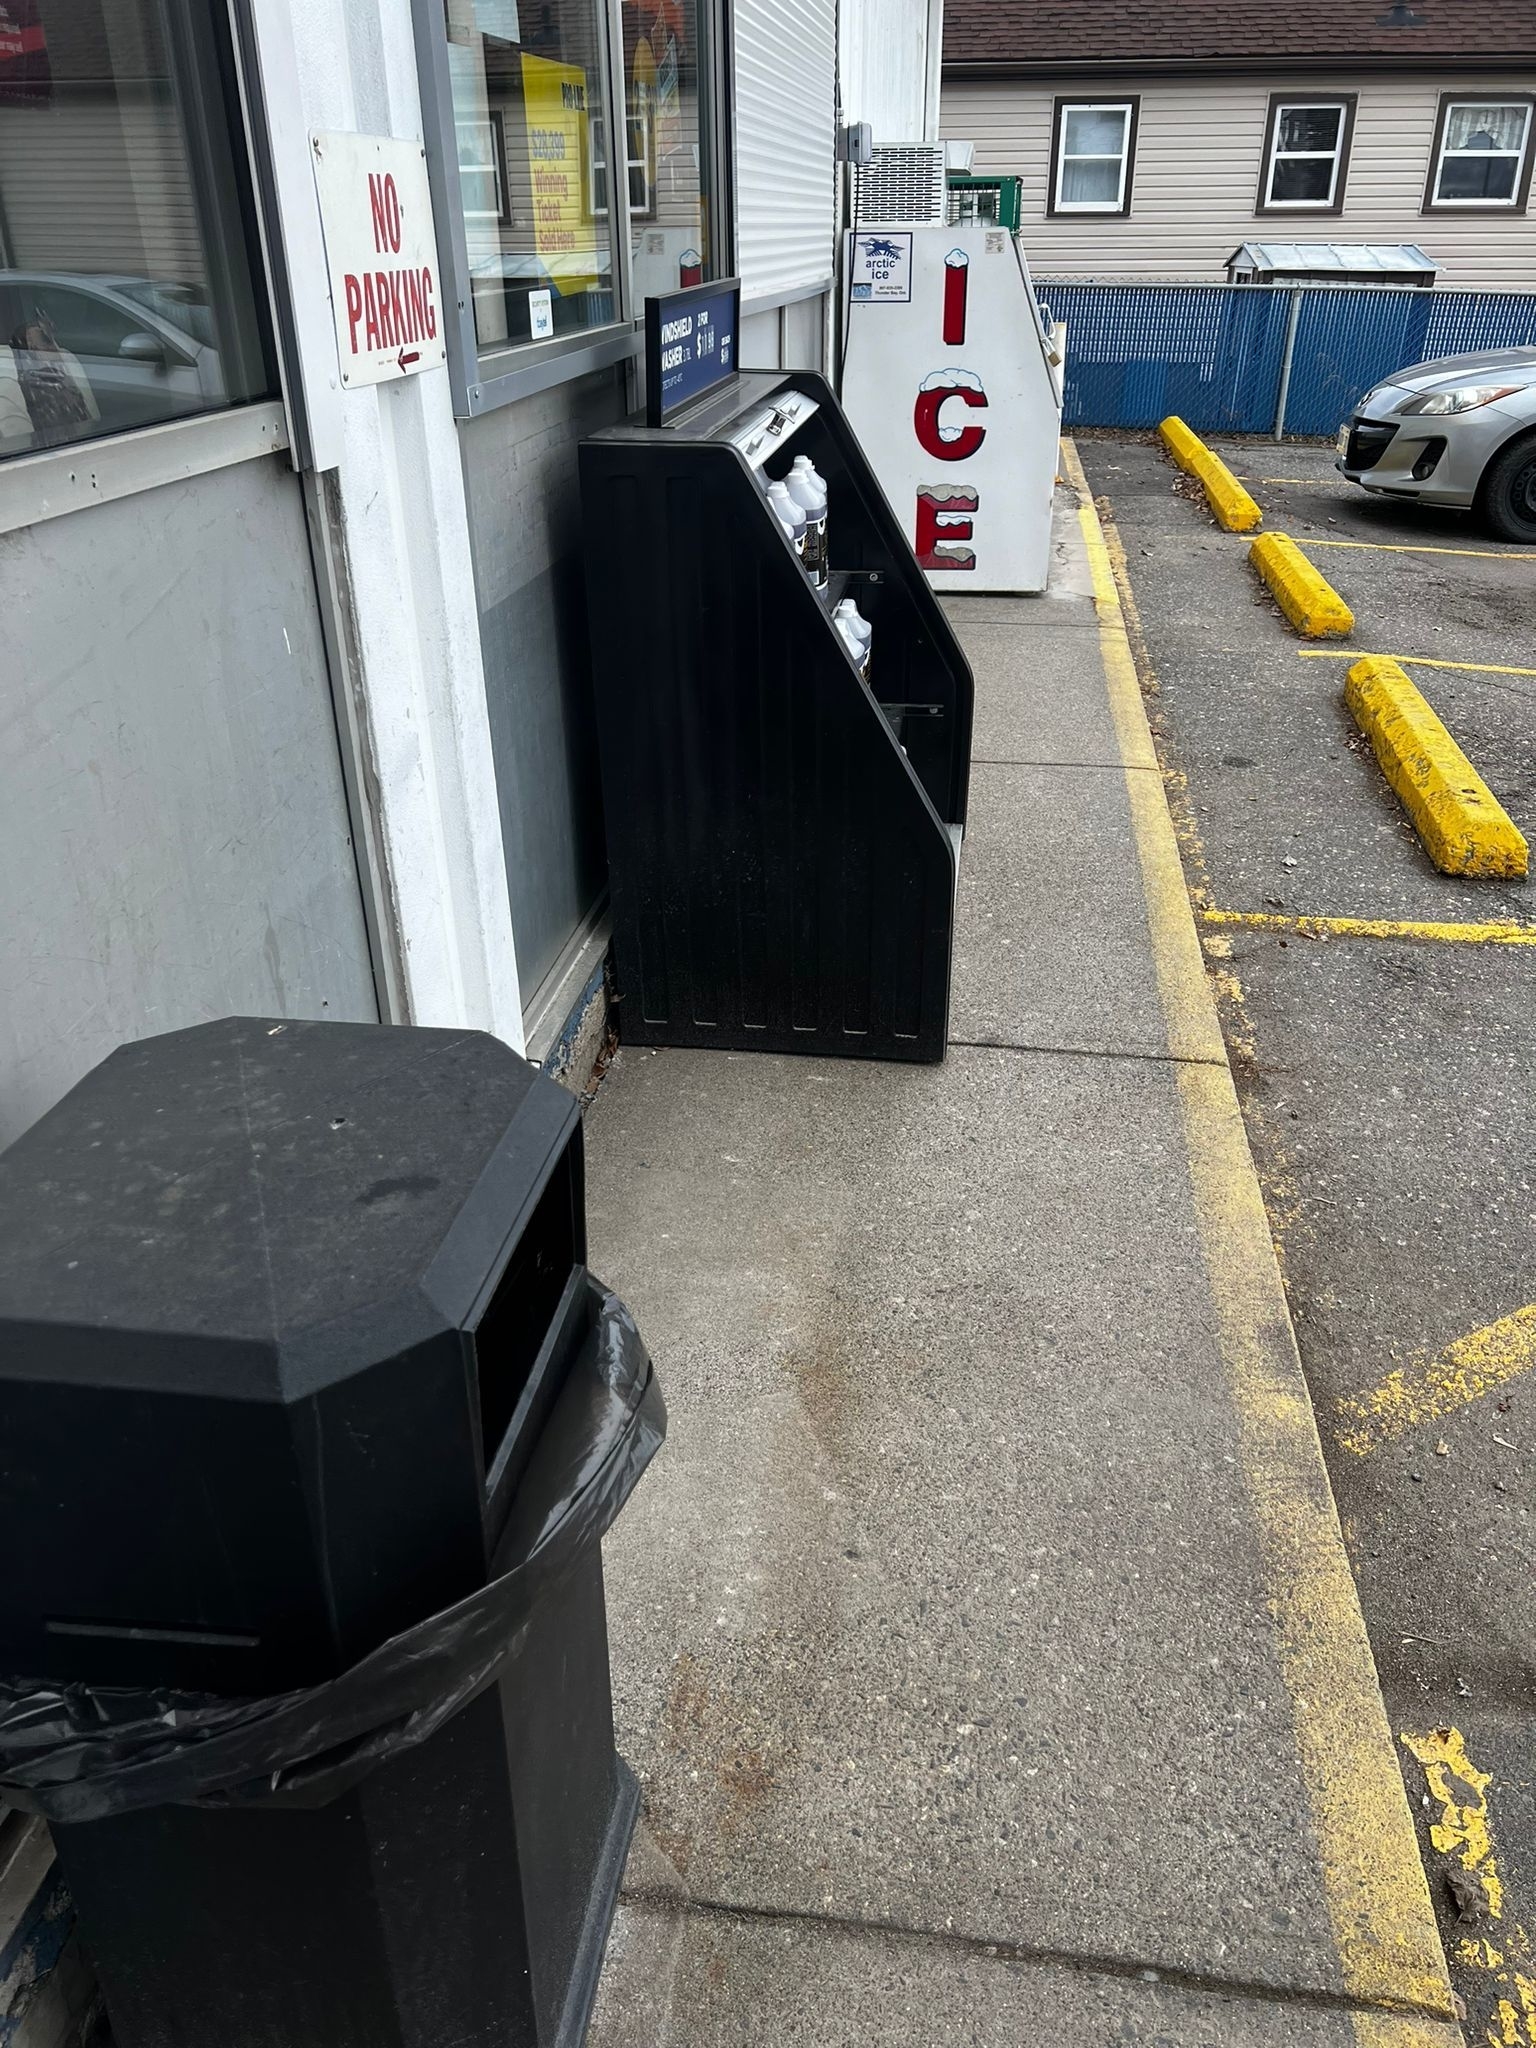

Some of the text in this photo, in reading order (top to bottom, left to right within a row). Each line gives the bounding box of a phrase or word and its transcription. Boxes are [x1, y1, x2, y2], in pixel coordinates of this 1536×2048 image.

[533, 165, 568, 201] Winning
[367, 172, 401, 254] NO
[536, 198, 561, 225] Ticket
[865, 258, 896, 269] arctic
[871, 268, 890, 280] ice
[343, 266, 437, 354] PARKING
